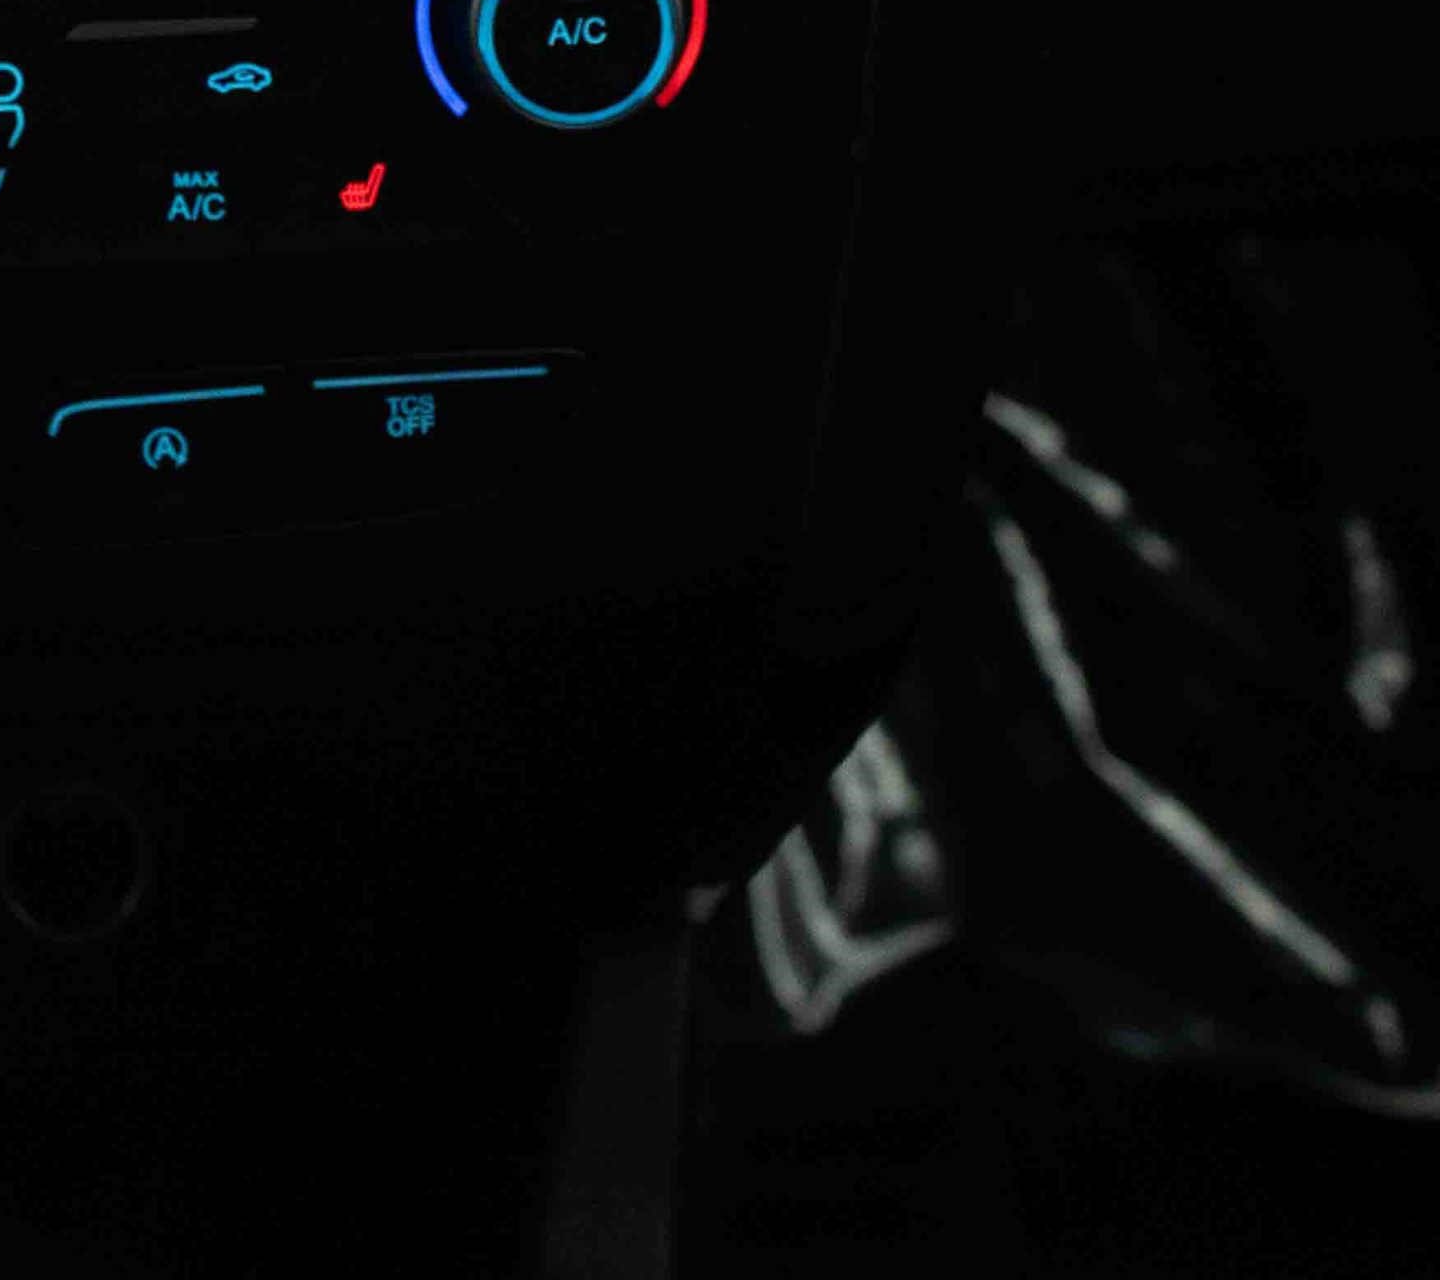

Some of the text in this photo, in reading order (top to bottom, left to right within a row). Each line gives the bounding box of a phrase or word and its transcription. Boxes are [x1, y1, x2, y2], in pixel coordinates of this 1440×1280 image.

[547, 16, 608, 47] A/C
[172, 171, 219, 188] MAX
[167, 192, 226, 222] A/C
[385, 394, 436, 416] TCS
[386, 415, 436, 438] OFF
